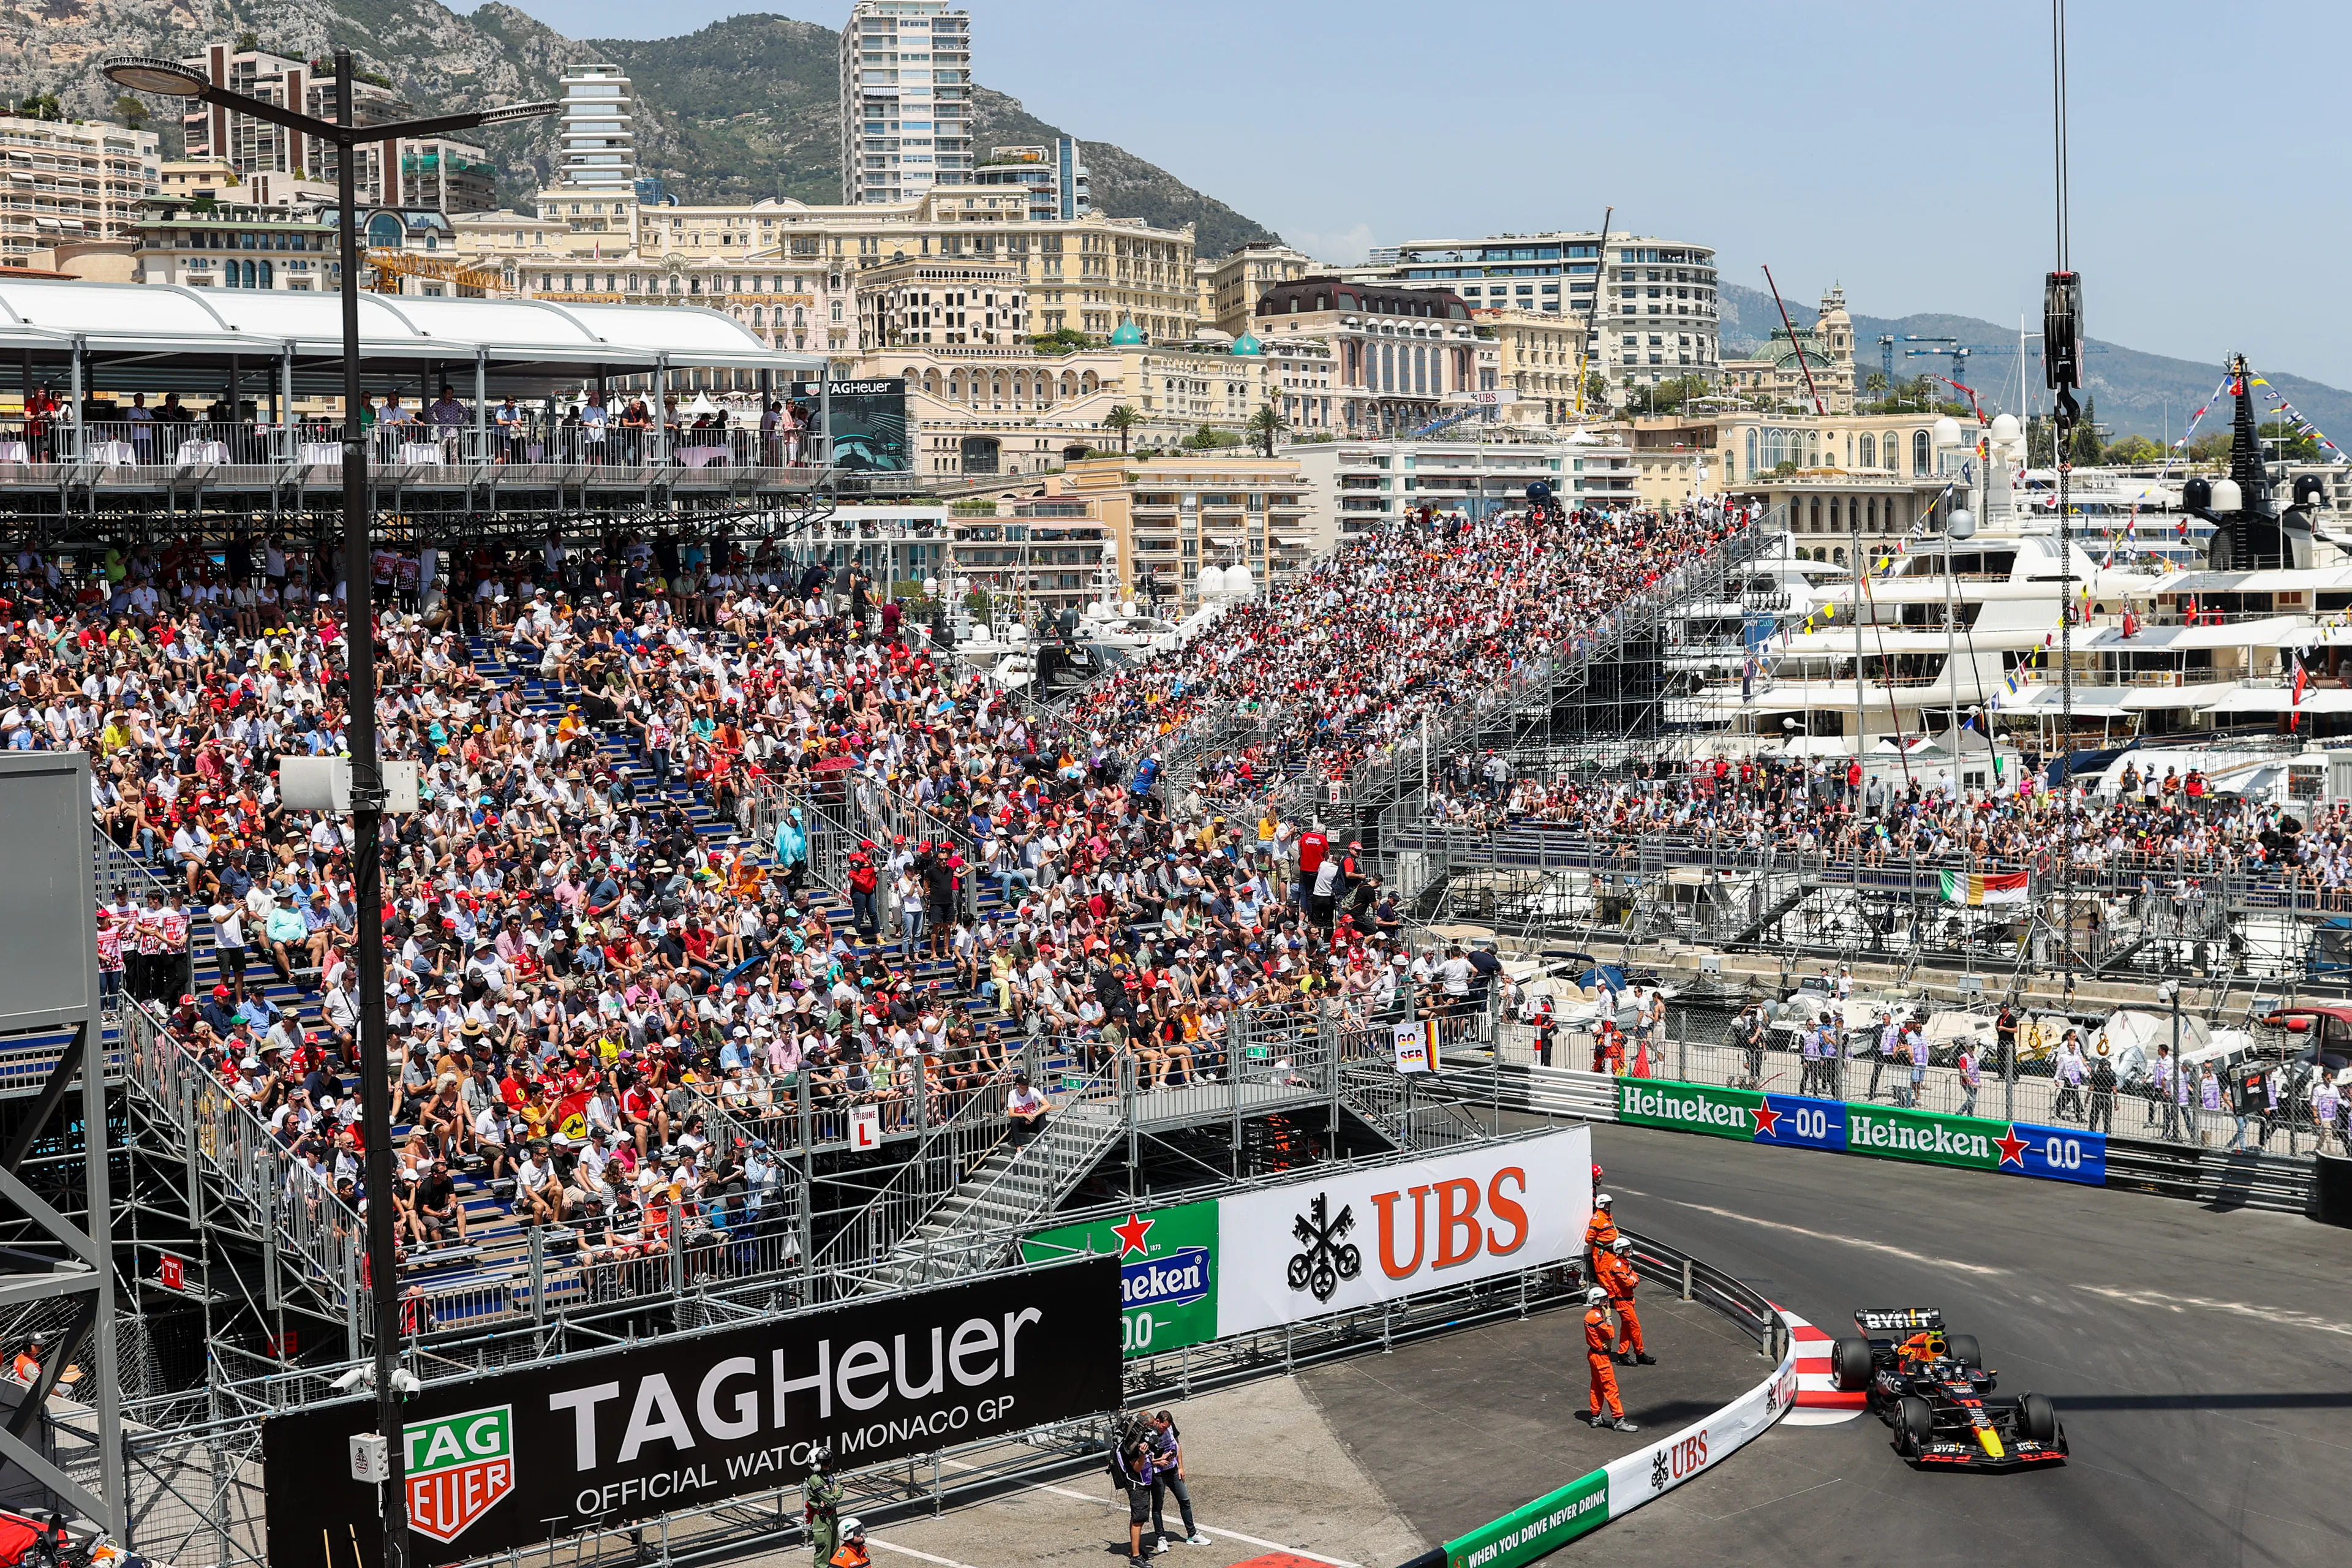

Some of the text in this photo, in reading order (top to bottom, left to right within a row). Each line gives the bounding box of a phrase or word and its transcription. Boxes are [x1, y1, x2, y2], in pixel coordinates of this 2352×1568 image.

[1479, 393, 1496, 403] UBS
[1332, 793, 1338, 802] P
[166, 924, 174, 933] 22
[1398, 1033, 1415, 1046] GO
[1400, 1049, 1424, 1063] SEB
[853, 1110, 876, 1121] TRIBUNE
[1623, 1085, 1826, 1139] Heineken 0.0
[858, 1123, 872, 1147] L
[1850, 1115, 2081, 1170] Heineken 0.0
[1371, 1166, 1529, 1281] UBS
[1150, 1243, 1161, 1252] 1873
[165, 1260, 178, 1270] TRIBUNE
[169, 1268, 174, 1279] L
[1121, 1265, 1200, 1302] neken
[1960, 1398, 1983, 1408] 11
[403, 1416, 500, 1471] TAG
[576, 1464, 717, 1515] OFFICIAL
[842, 1405, 969, 1455] MONACO
[978, 1395, 1014, 1422] GP
[1672, 1429, 1708, 1479] UBS
[405, 1464, 507, 1534] EUER
[1468, 1488, 1607, 1568] WHEN YOU DRIVE NEVER DRINK
